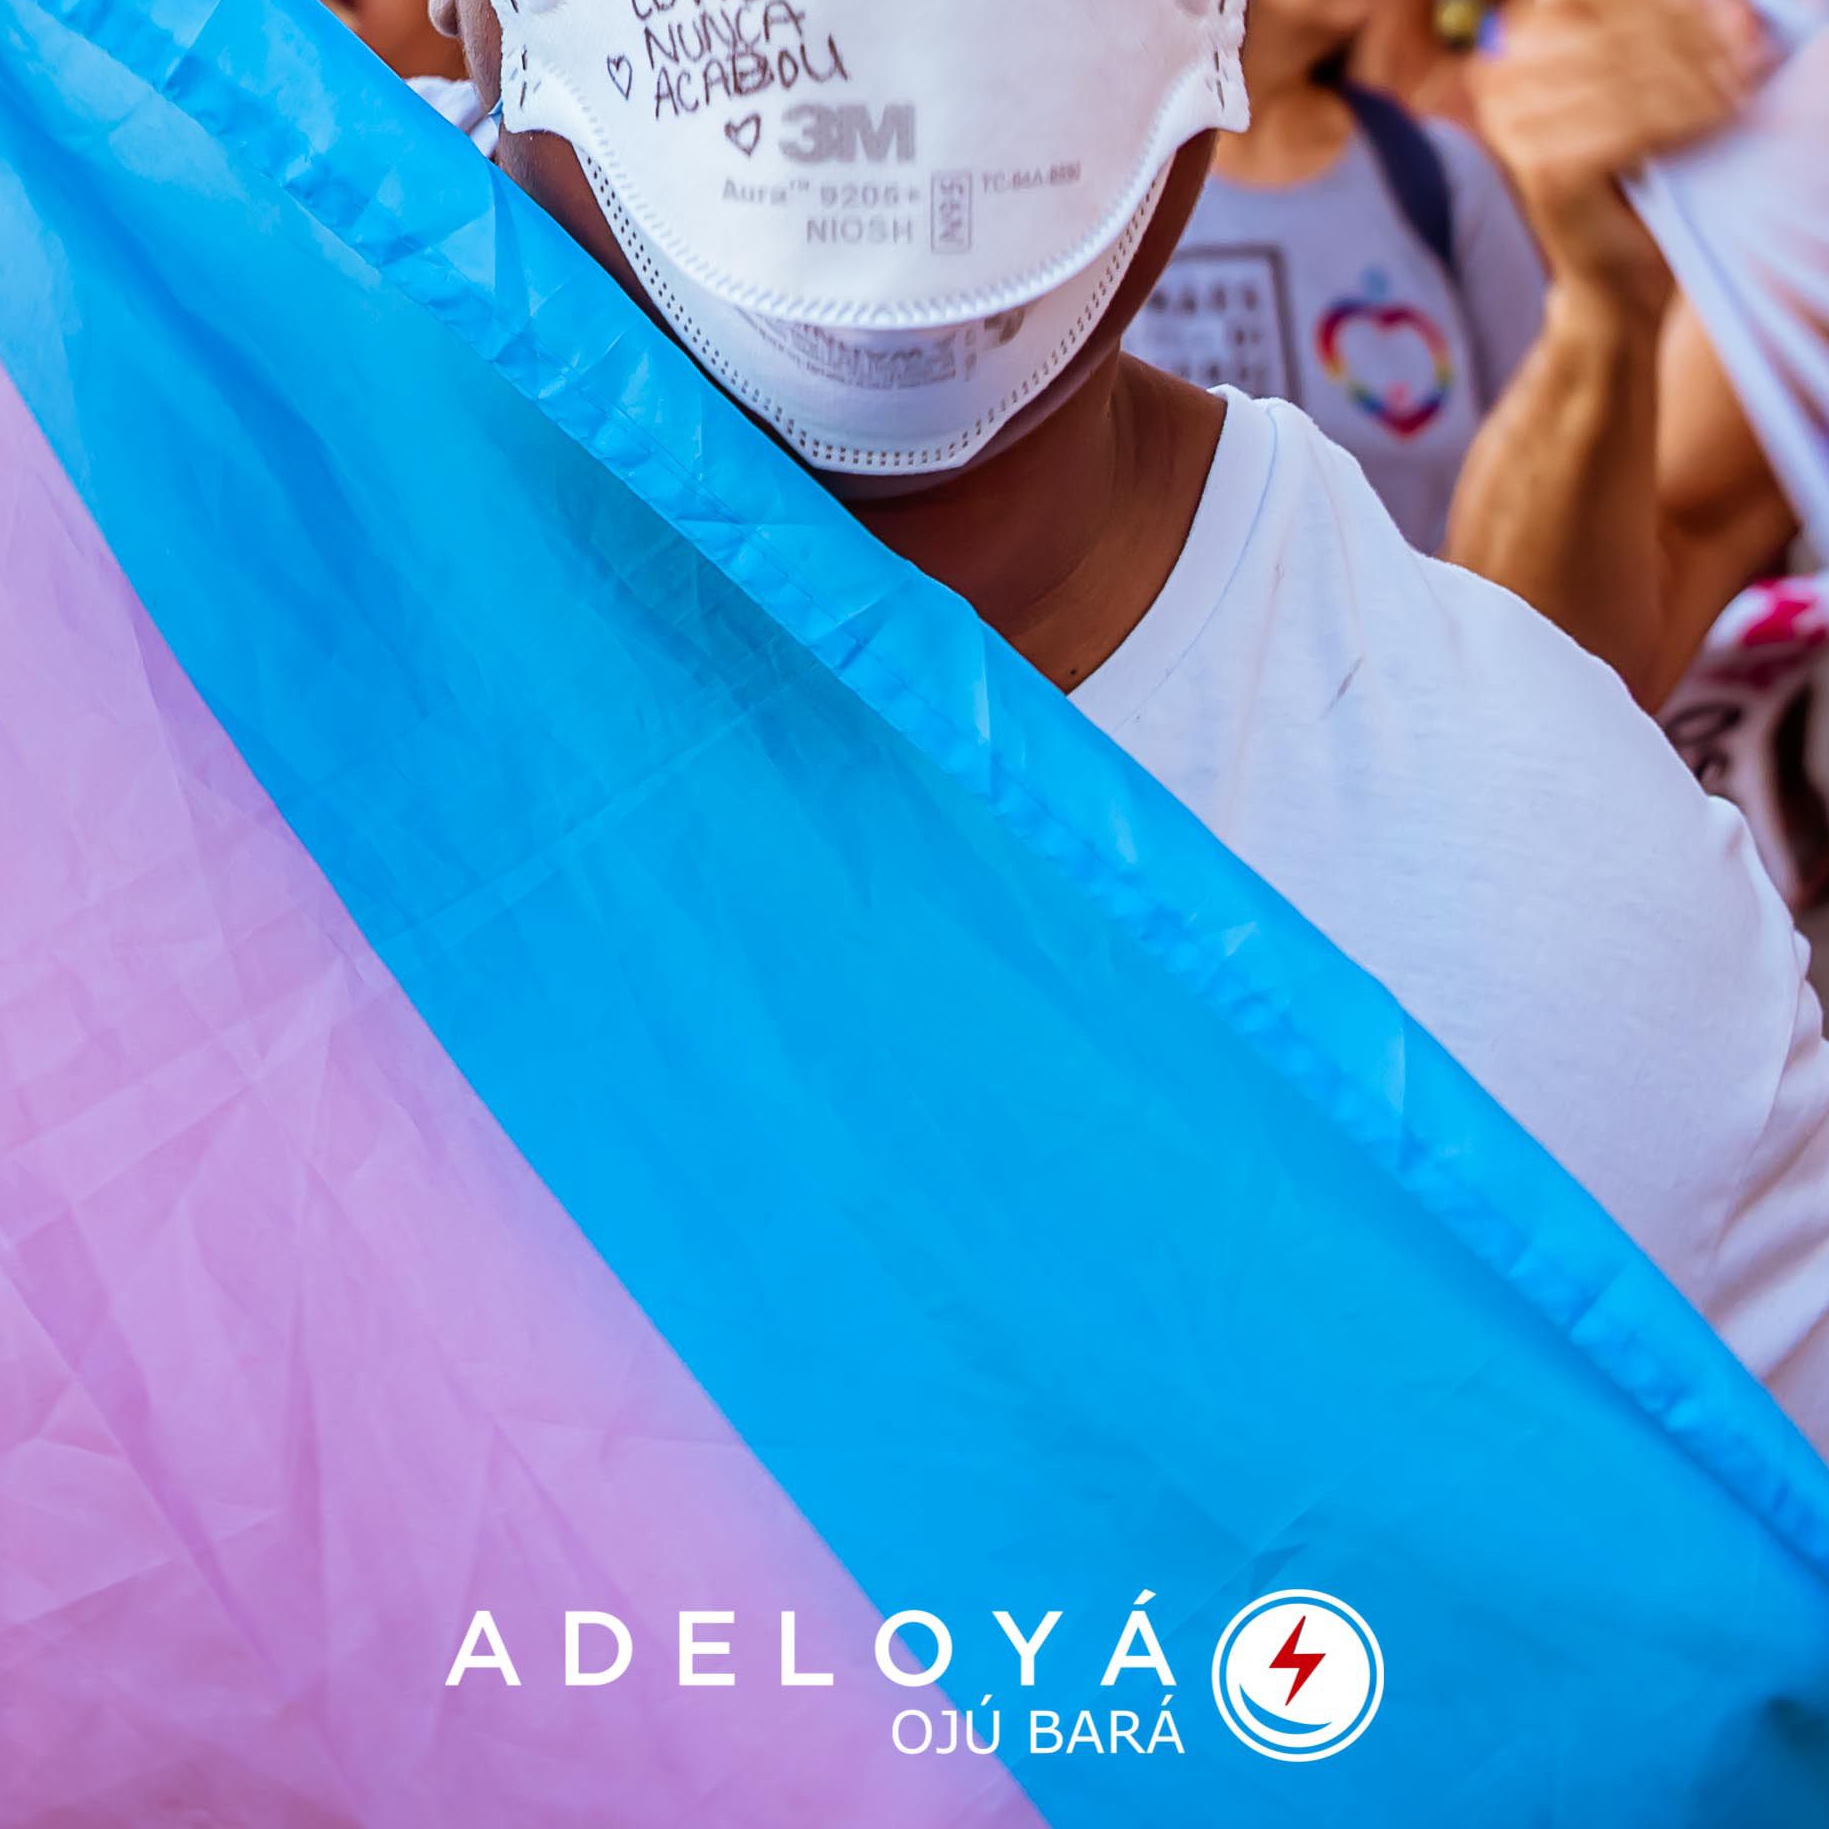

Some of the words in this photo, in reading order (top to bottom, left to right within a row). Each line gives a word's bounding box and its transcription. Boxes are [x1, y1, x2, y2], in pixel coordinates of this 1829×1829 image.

[653, 32, 849, 121] ACABOU
[777, 102, 917, 166] 3M
[806, 215, 913, 245] NIOSH
